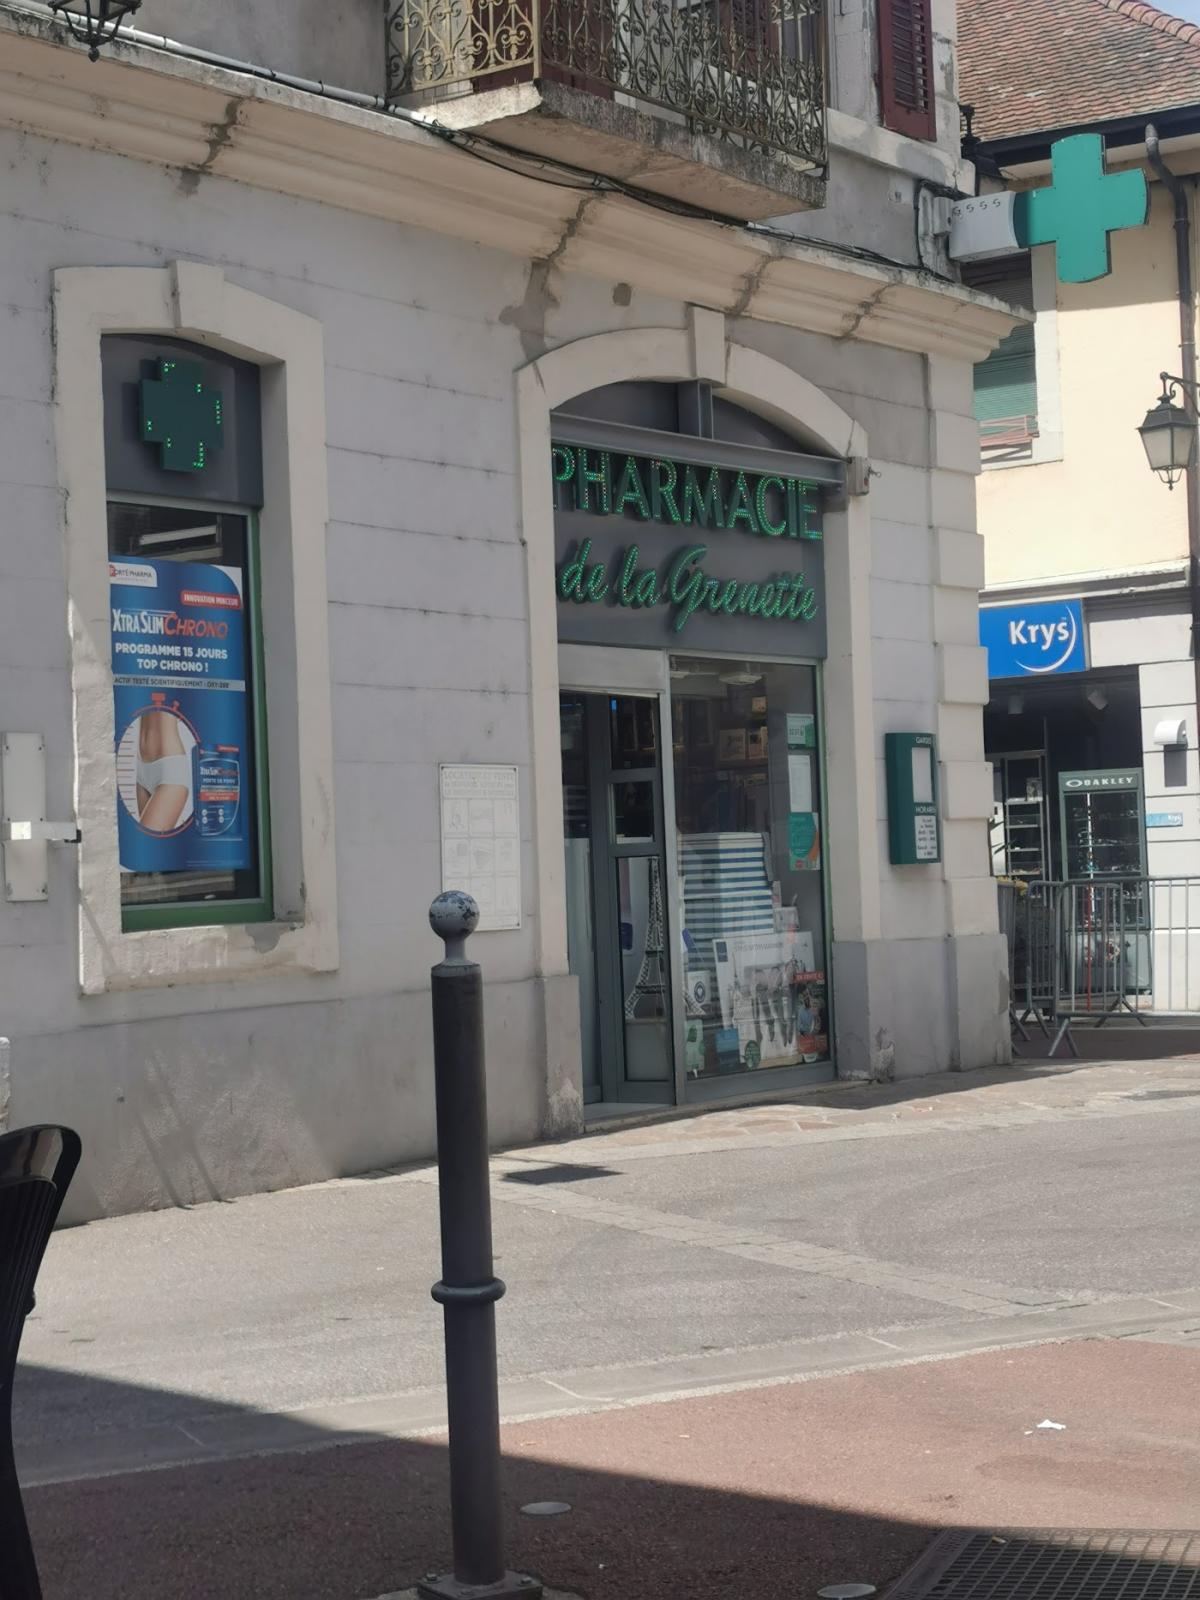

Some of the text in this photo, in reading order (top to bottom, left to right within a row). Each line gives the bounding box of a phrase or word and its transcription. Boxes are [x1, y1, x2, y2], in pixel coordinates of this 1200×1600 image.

[552, 447, 823, 540] PHARMACIE
[559, 537, 820, 632] de la Grenette
[1009, 619, 1070, 651] Krys
[115, 643, 228, 659] PROGRAMME 15 JOURS
[137, 659, 158, 669] TOP
[160, 661, 203, 672] CHRONO
[1083, 777, 1134, 786] OAKLEY
